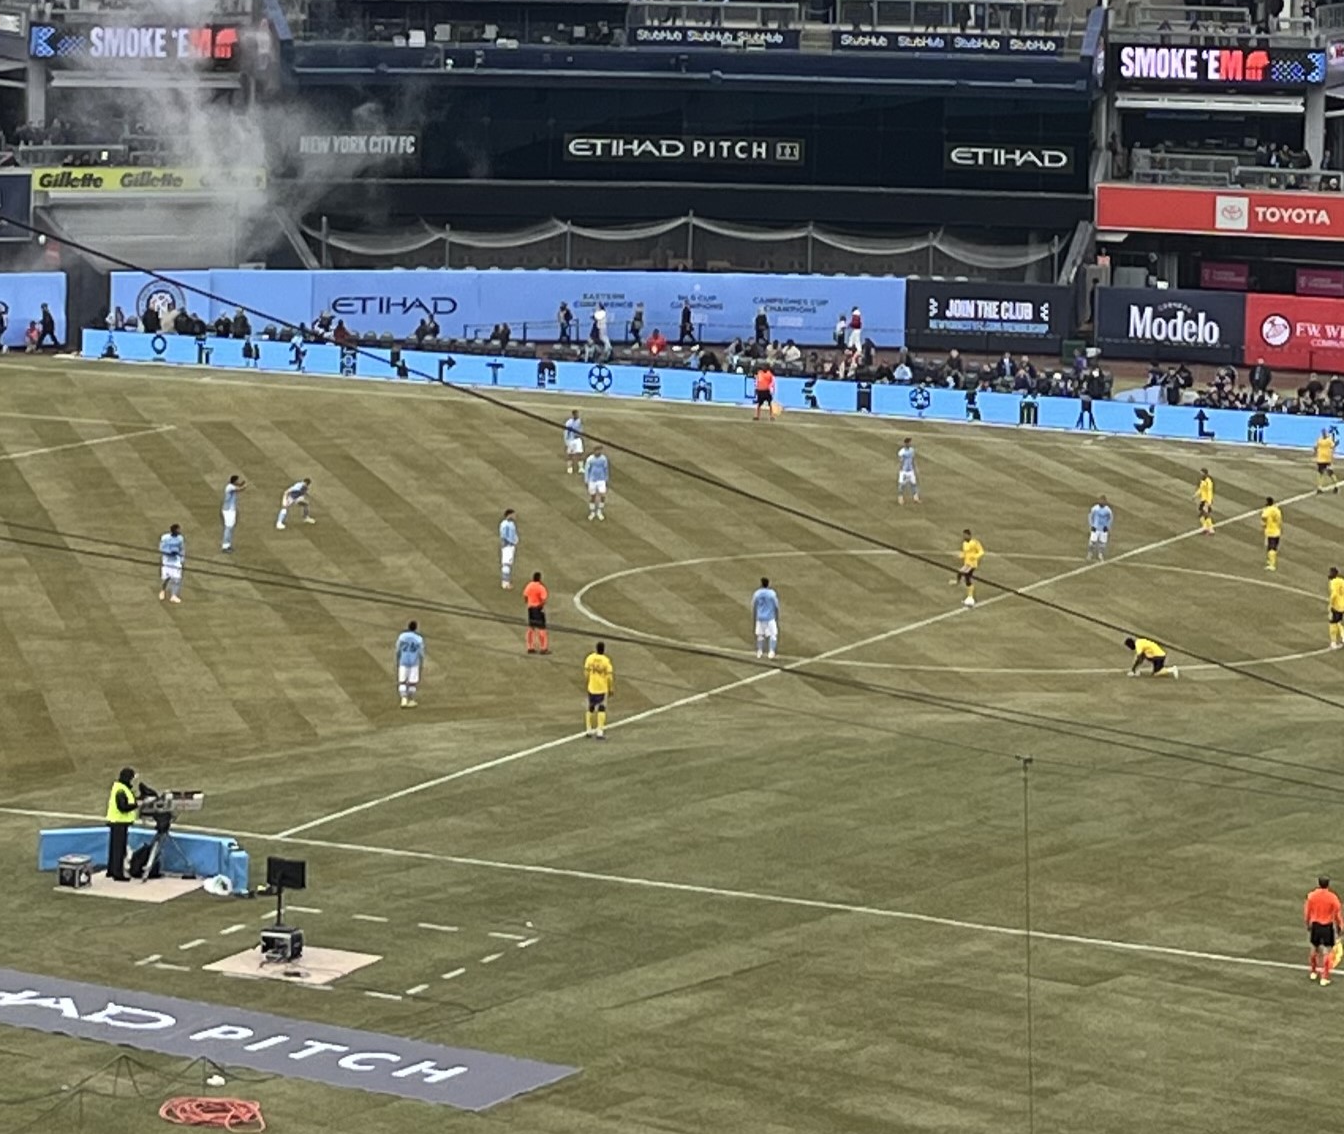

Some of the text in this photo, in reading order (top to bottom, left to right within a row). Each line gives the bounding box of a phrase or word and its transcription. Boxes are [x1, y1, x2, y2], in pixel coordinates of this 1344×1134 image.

[89, 25, 167, 58] SMOKE
[1119, 45, 1198, 82] SMOKE
[369, 135, 399, 154] CITY
[399, 135, 417, 154] FC
[568, 138, 767, 159] ETIHAD PITCH
[949, 145, 1068, 169] ETIHAD
[38, 170, 104, 189] Gillette
[1254, 205, 1331, 226] TOYOTA
[330, 295, 458, 316] ETIHAD
[945, 298, 1034, 320] JOIN THE CLUB
[1128, 304, 1220, 345] Modelo
[189, 1023, 471, 1086] PITCH
